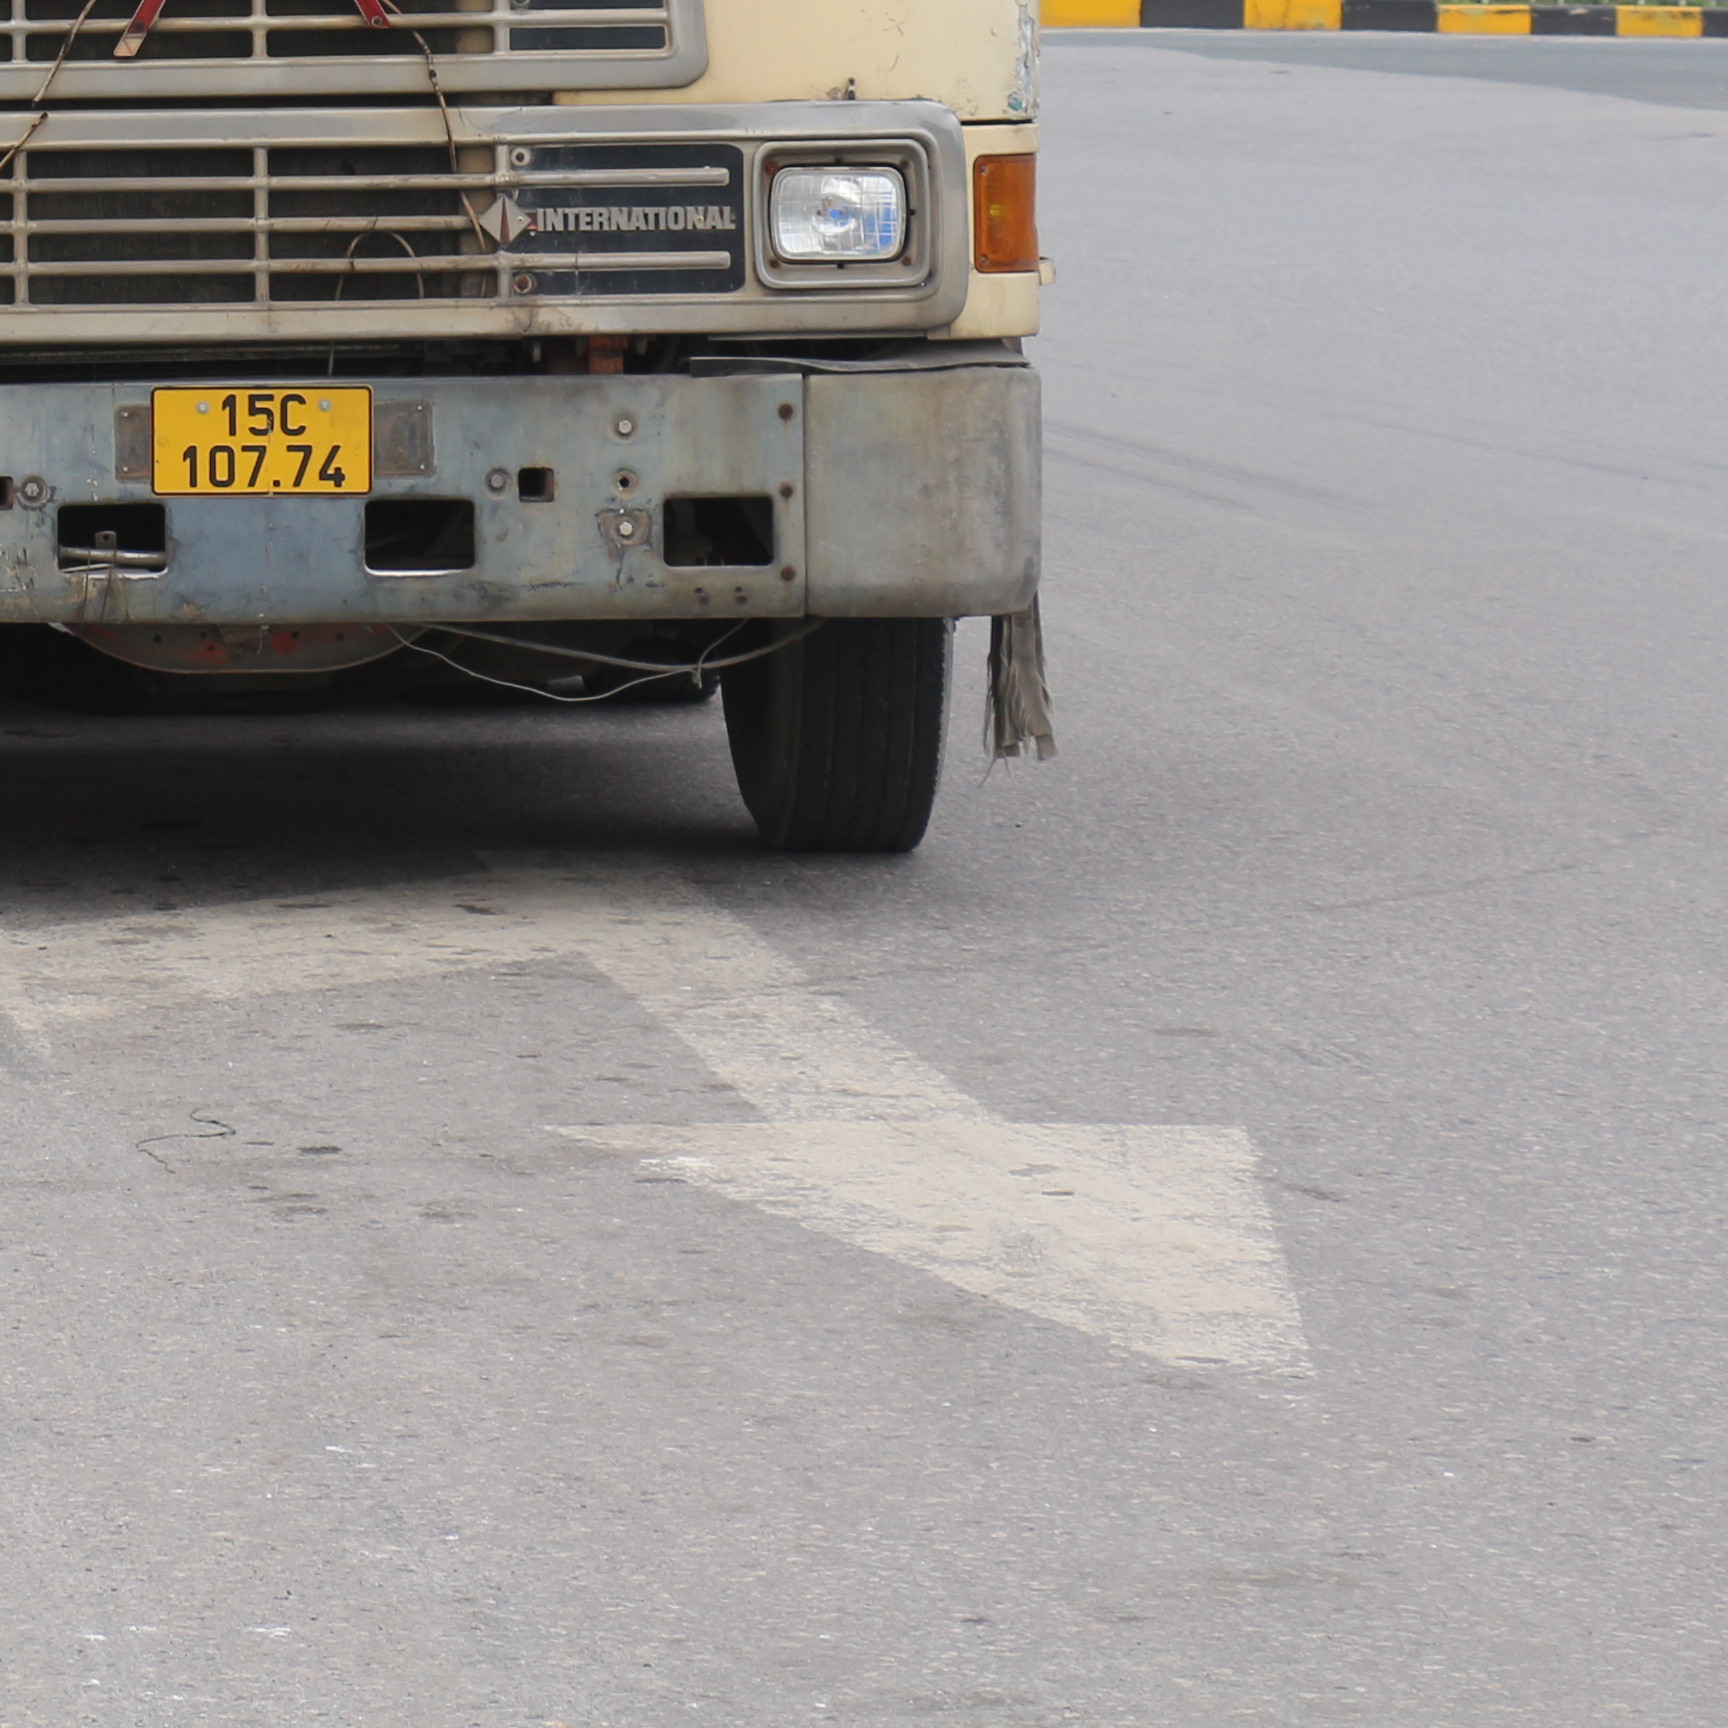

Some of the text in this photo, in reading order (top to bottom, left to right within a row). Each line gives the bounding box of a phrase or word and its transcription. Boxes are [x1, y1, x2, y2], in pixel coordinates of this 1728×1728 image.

[536, 205, 736, 232] INTERNATIONAL
[222, 393, 307, 436] 15C
[182, 444, 346, 488] 107.74
